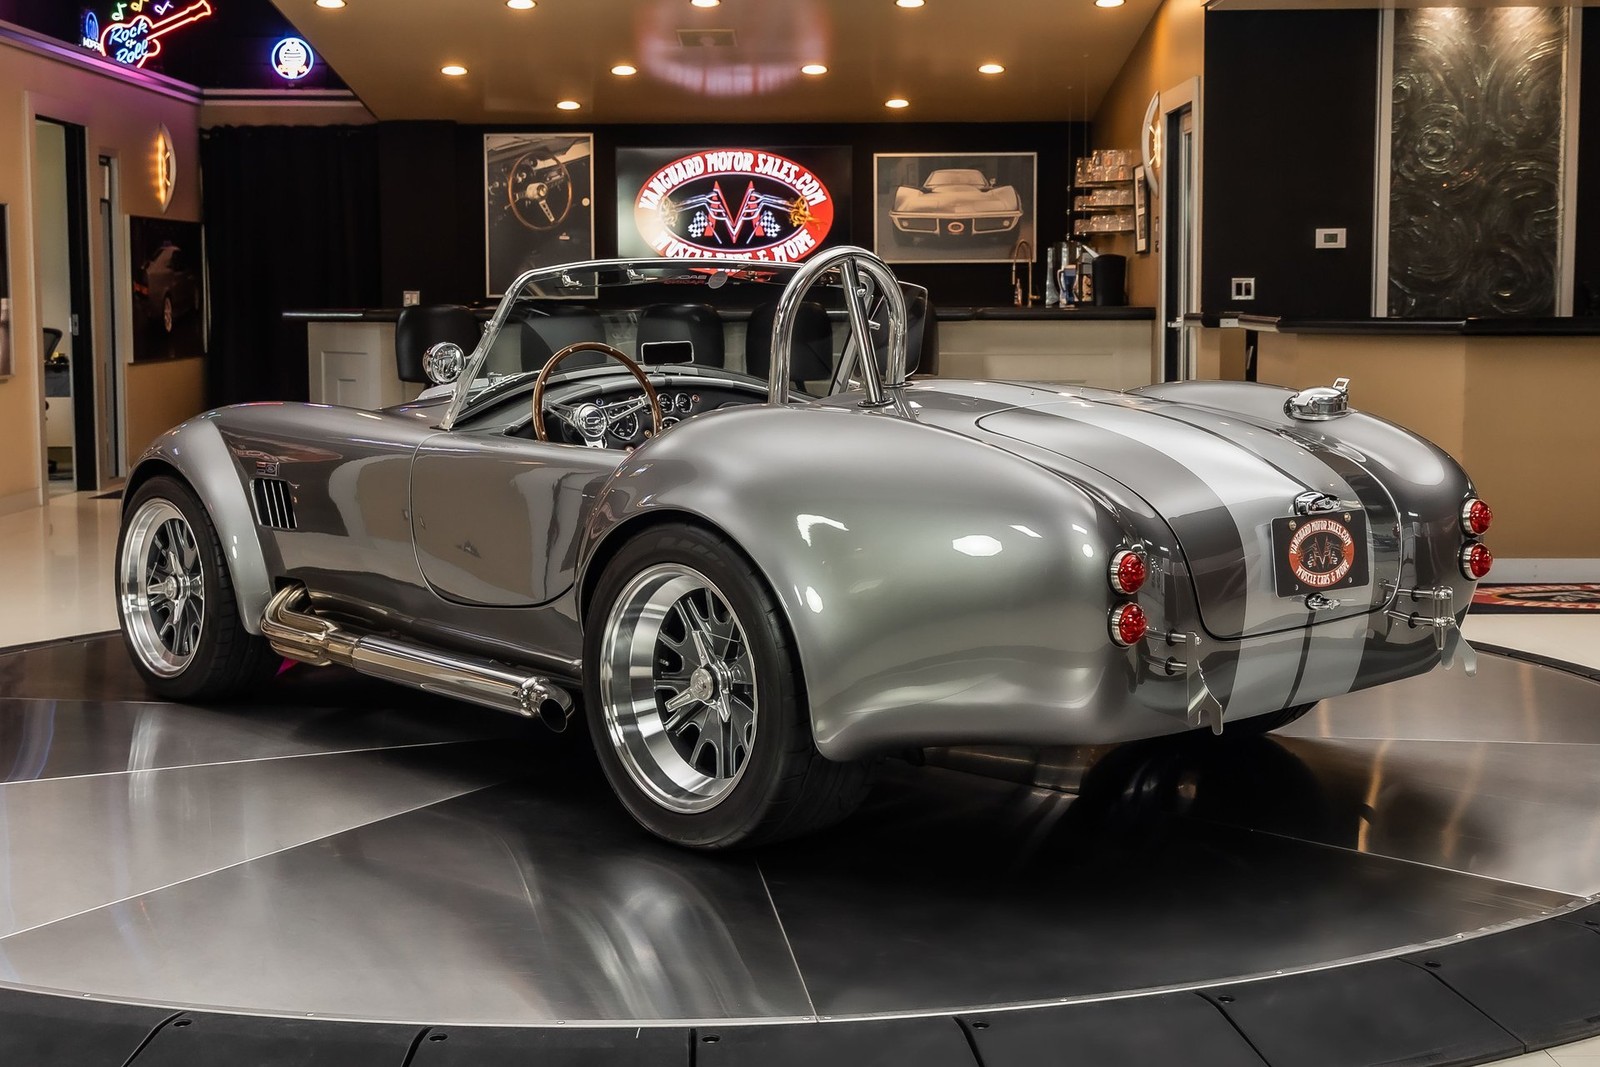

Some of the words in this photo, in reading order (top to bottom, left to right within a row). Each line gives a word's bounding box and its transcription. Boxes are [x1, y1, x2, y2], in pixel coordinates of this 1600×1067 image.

[109, 18, 148, 45] Rock
[116, 40, 148, 63] Roll
[638, 156, 704, 210] VANGUARD
[705, 152, 754, 173] MOTOR
[755, 153, 827, 206] SALES.COM
[771, 229, 816, 262] MORE
[1291, 523, 1311, 554] VANGUARD
[1311, 520, 1327, 531] MOTOR
[1328, 520, 1352, 546] SALES.COM
[1297, 566, 1316, 585] MUSCLE
[1317, 574, 1330, 585] CARS
[1336, 560, 1350, 579] MORE
